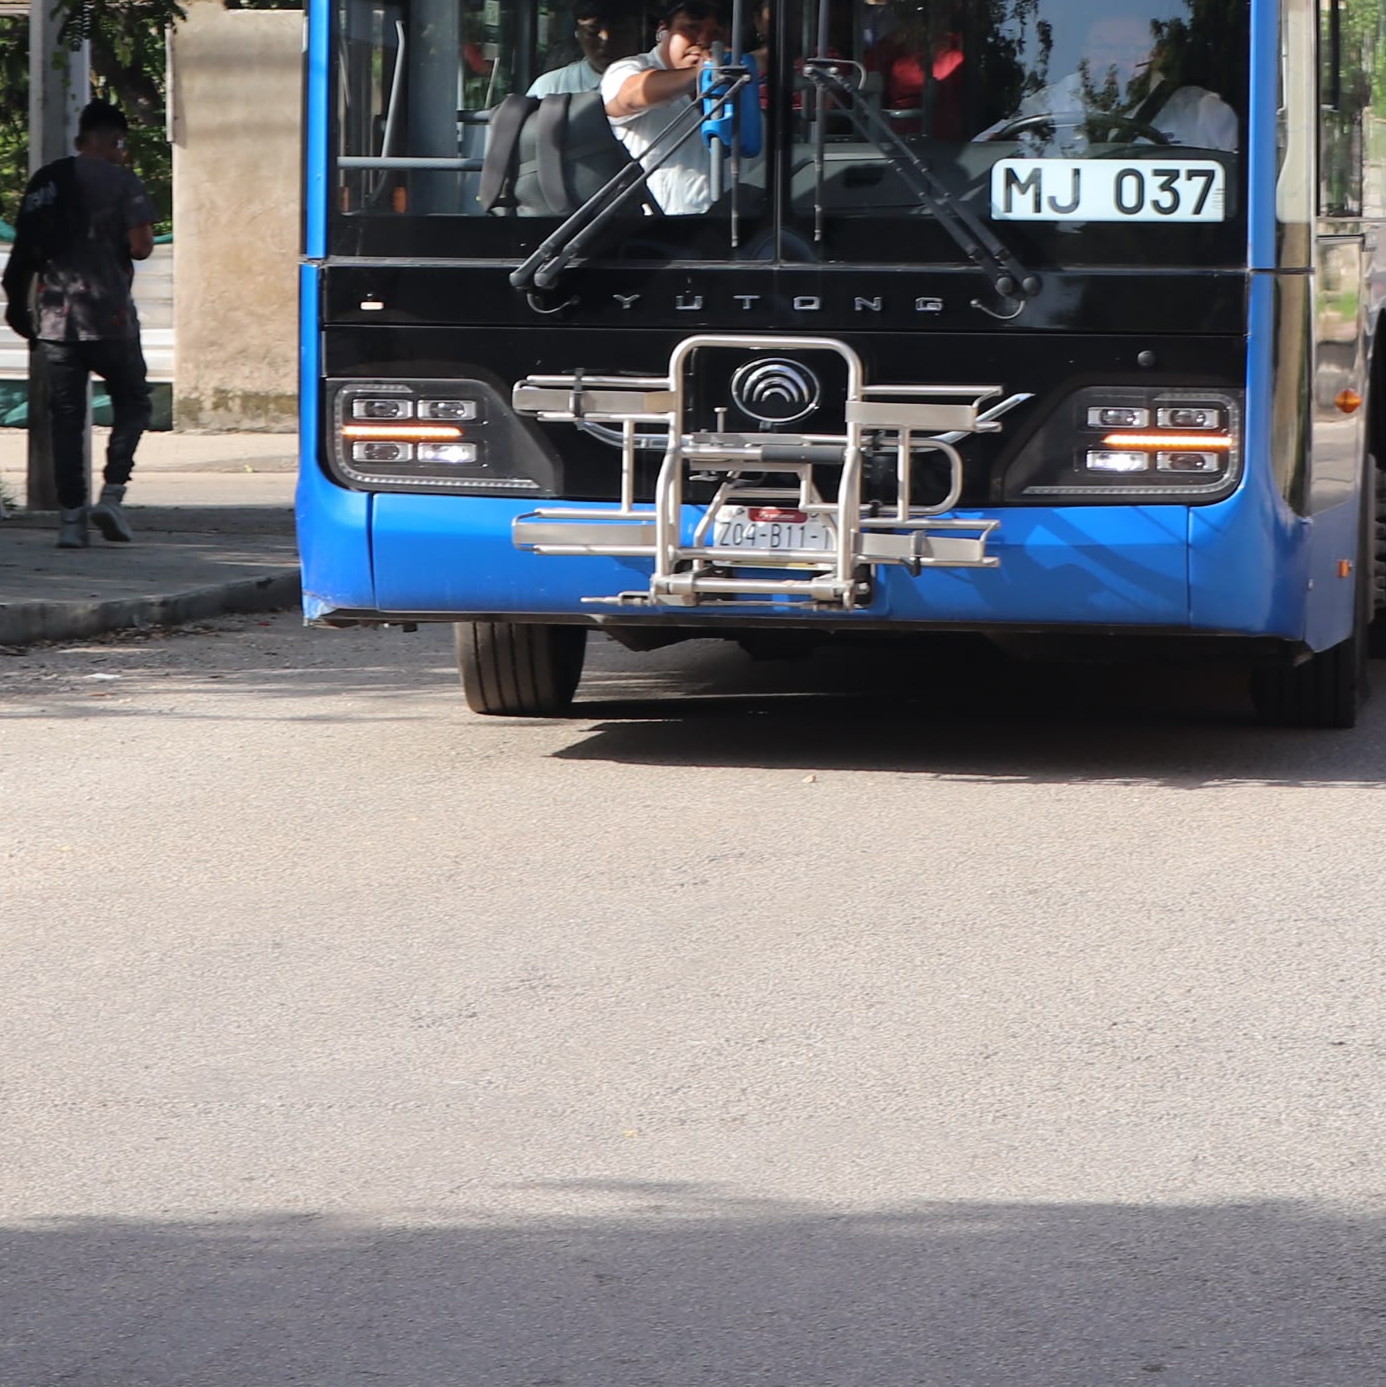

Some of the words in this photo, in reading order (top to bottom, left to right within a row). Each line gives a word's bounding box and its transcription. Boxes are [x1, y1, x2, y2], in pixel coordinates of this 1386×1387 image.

[1003, 167, 1082, 214] MJ
[1116, 168, 1216, 216] 037
[613, 294, 943, 312] YUTONG
